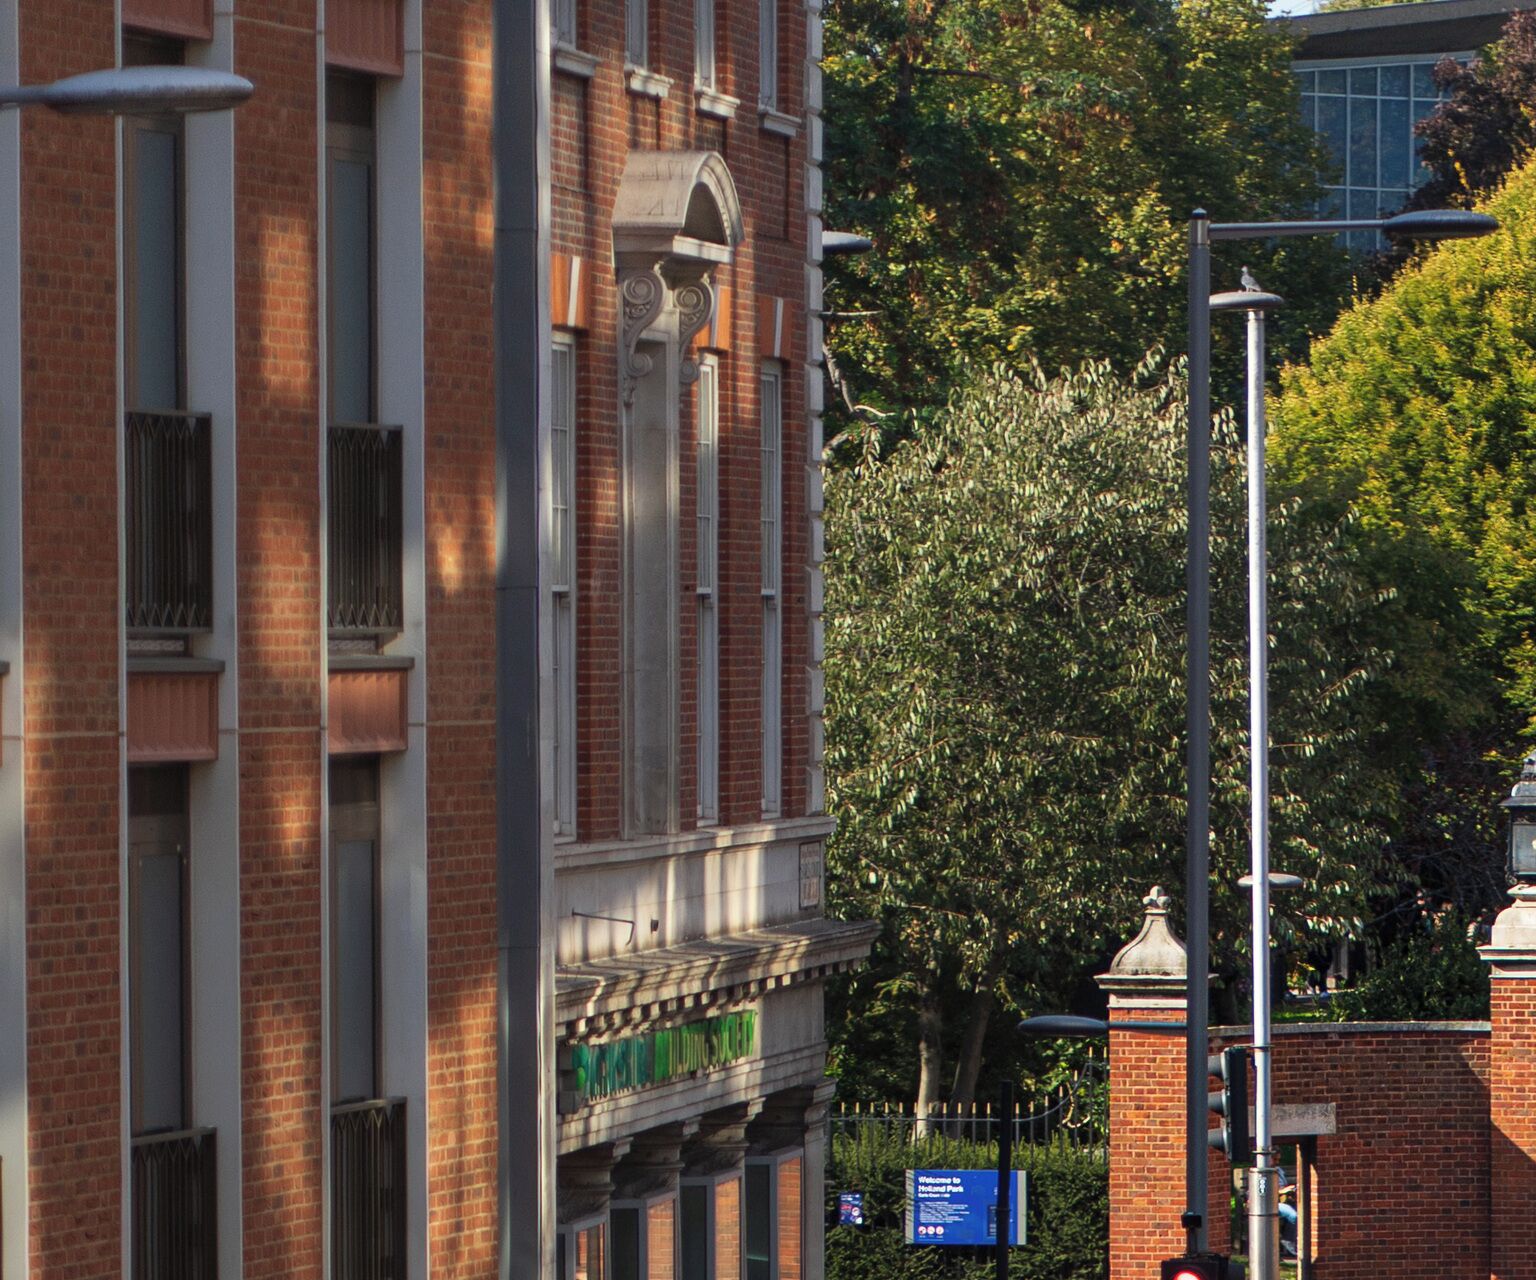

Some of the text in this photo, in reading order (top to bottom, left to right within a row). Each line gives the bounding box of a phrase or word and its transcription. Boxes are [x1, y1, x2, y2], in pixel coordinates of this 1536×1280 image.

[918, 1176, 961, 1184] Welcome to
[918, 1185, 964, 1193] Holland Park
